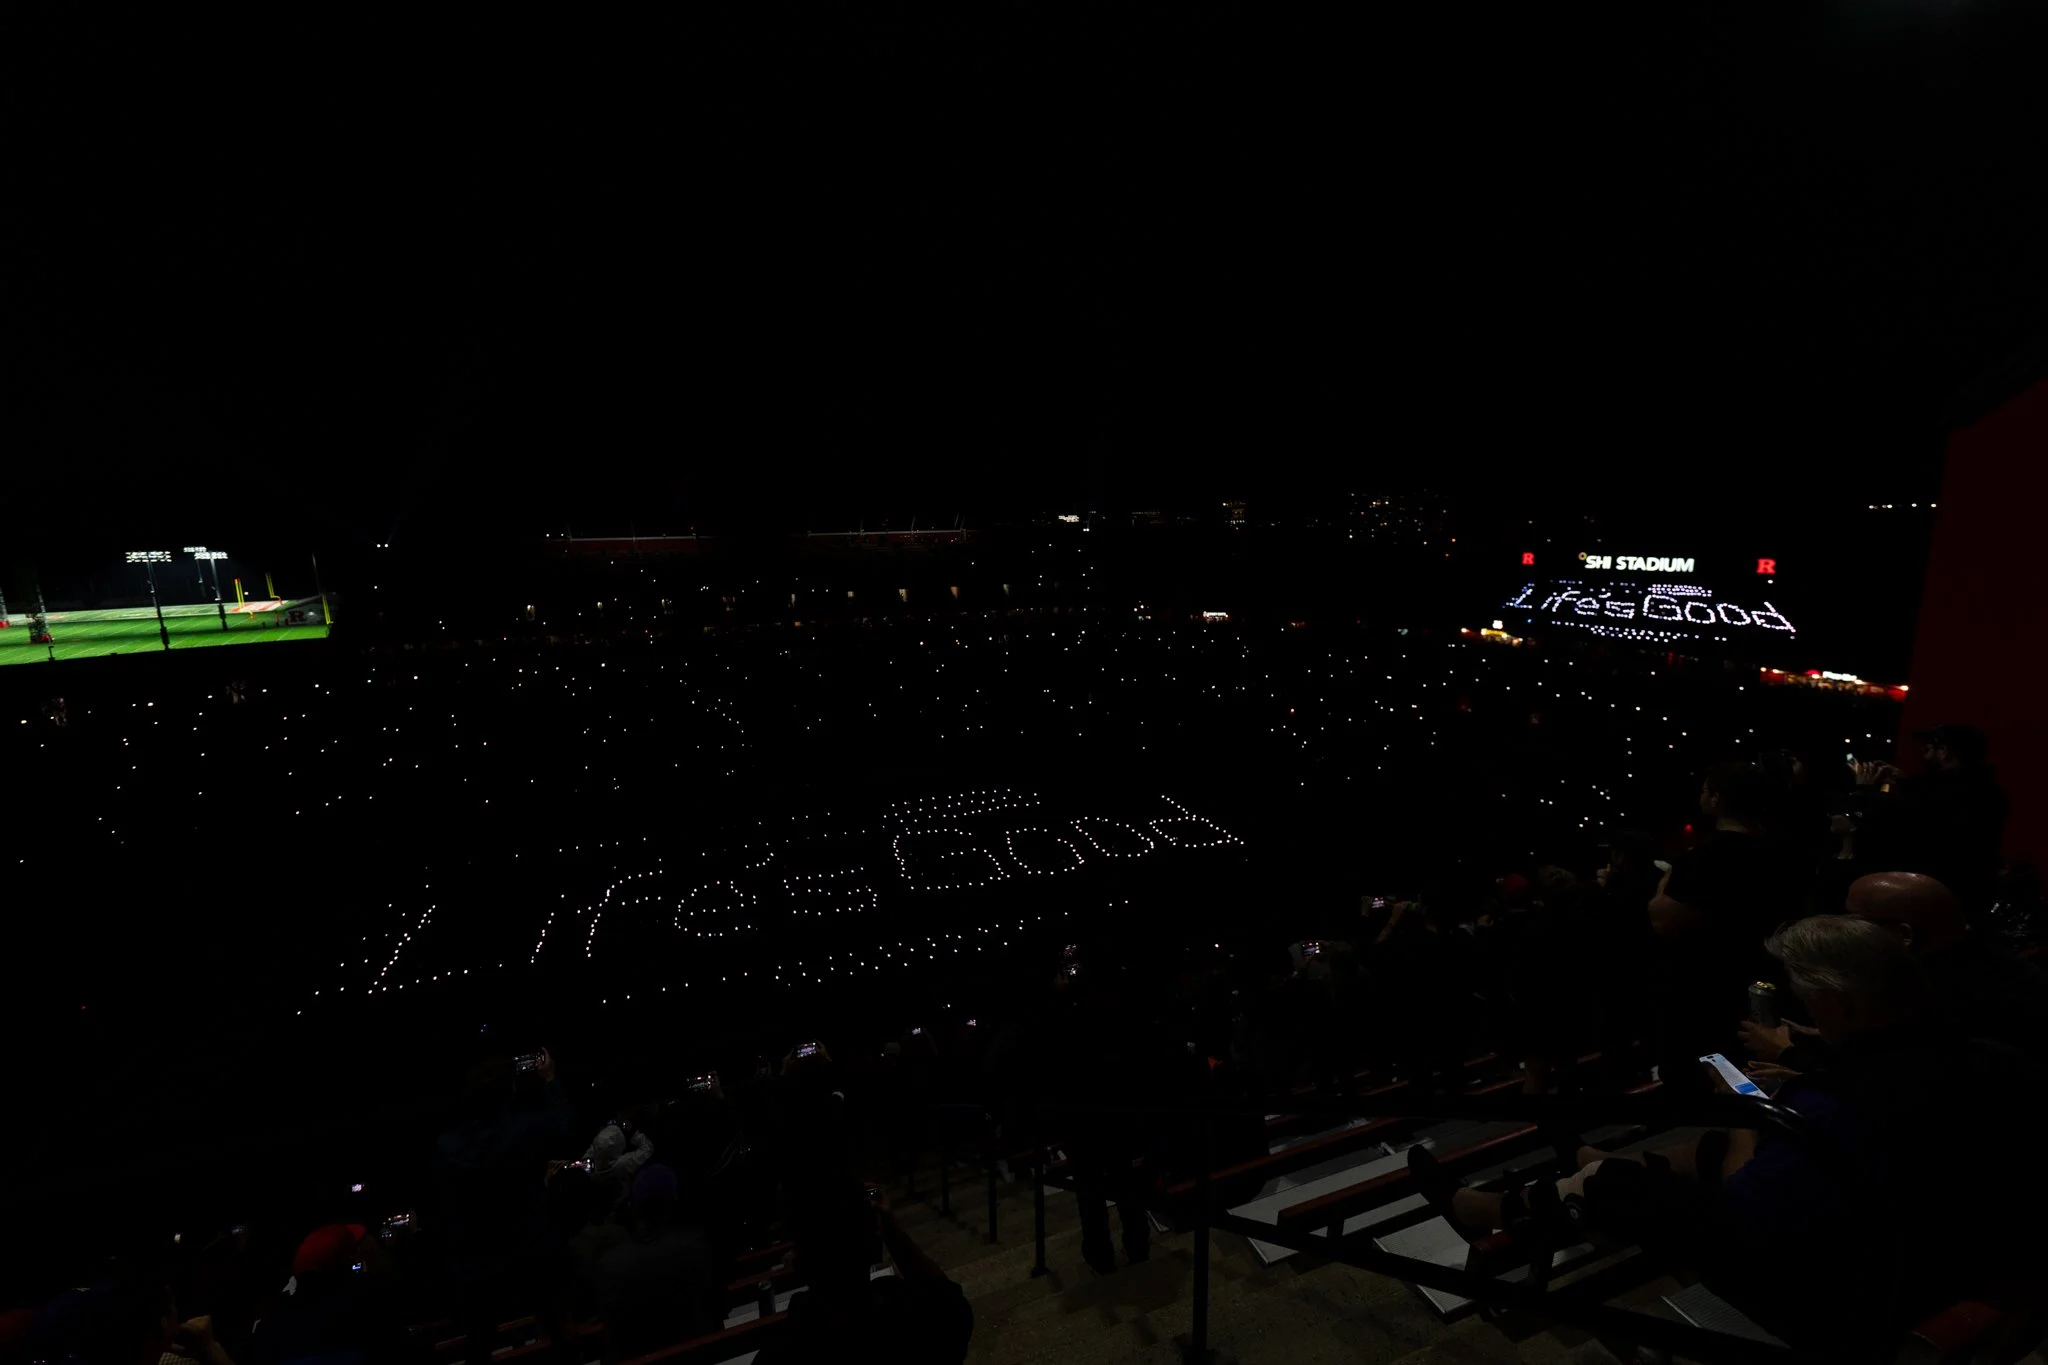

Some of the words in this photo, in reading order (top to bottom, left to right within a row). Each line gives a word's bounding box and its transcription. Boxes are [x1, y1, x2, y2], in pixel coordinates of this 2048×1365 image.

[1522, 553, 1535, 566] R
[1585, 555, 1611, 570] SHI
[1616, 556, 1695, 573] STADIUM
[1757, 558, 1776, 575] R
[1642, 594, 1796, 633] Good
[893, 795, 1244, 891] Good
